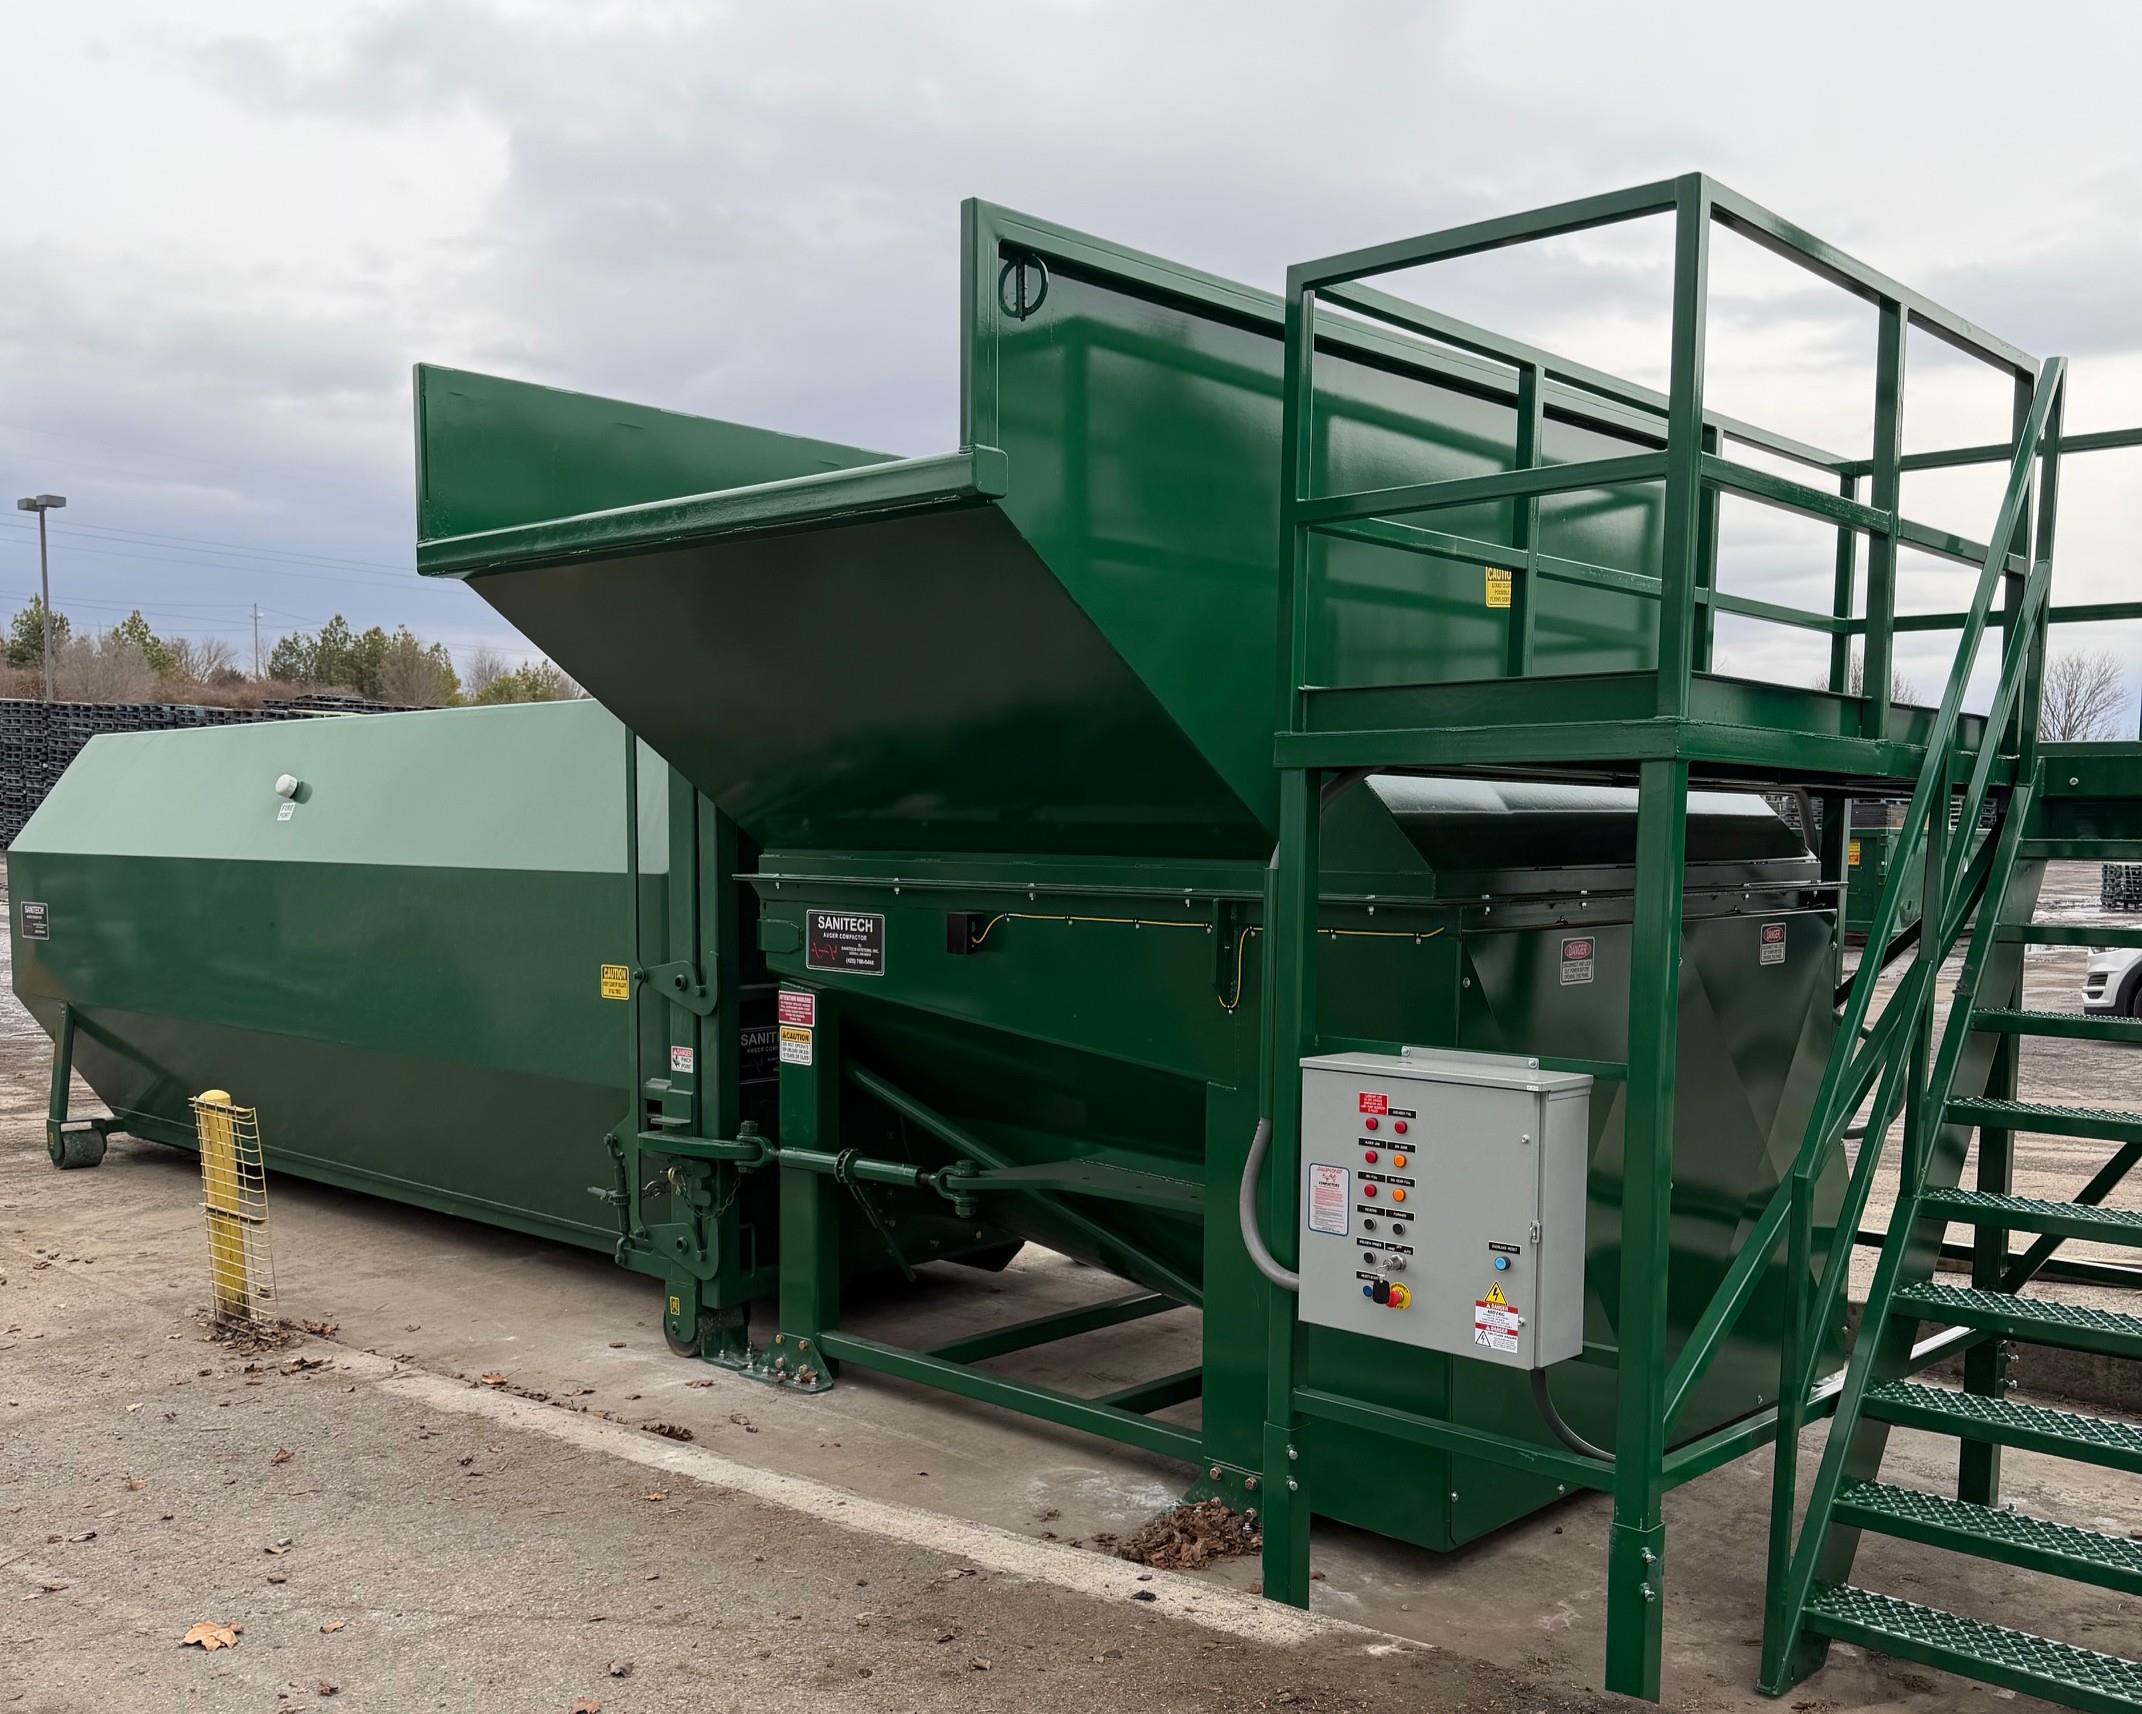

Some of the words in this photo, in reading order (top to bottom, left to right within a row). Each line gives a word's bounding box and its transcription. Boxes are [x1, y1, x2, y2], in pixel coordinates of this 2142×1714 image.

[1488, 567, 1512, 580] CAUTIO
[818, 916, 872, 932] SANITECH
[1568, 943, 1588, 956] DANGER
[604, 967, 626, 980] CAUTION
[740, 1032, 777, 1046] SANIT
[786, 1031, 809, 1042] CAUTION
[1491, 1303, 1508, 1312] DANGER
[1490, 1326, 1508, 1334] DANGER
